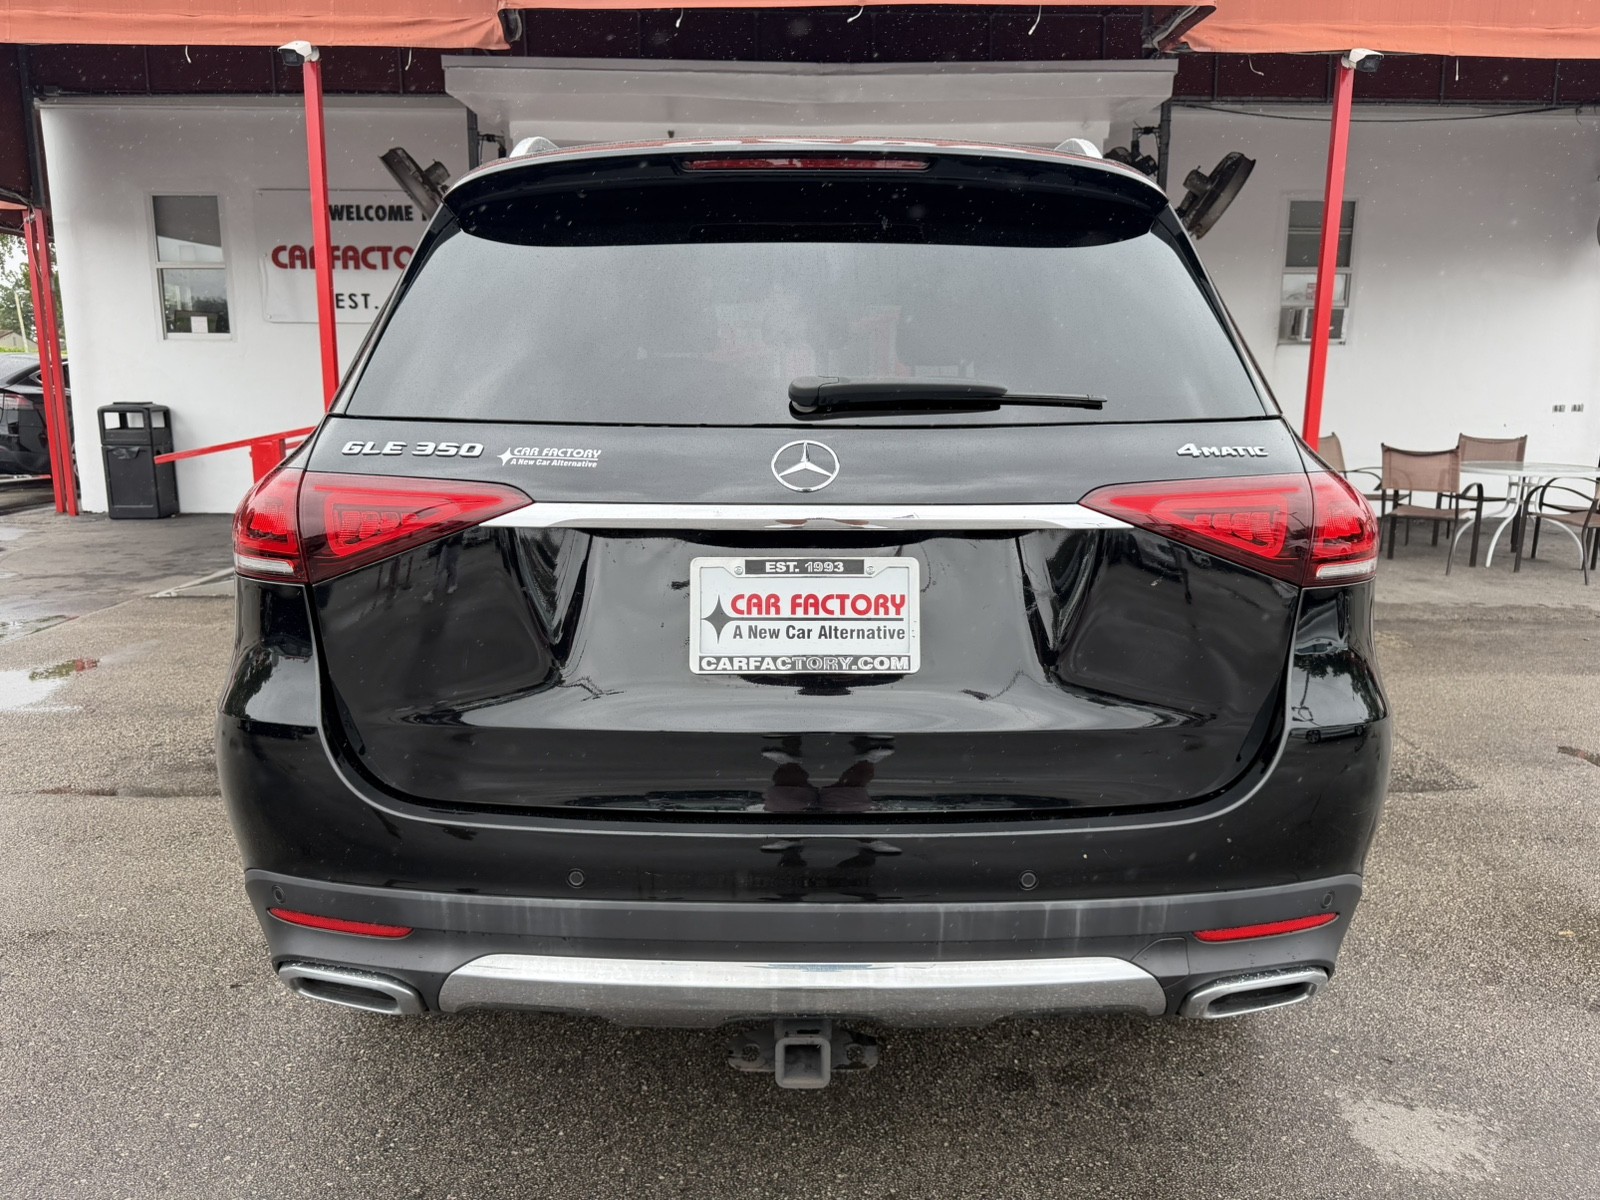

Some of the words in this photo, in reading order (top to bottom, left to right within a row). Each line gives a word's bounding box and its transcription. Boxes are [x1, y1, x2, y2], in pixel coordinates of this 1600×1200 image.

[329, 204, 414, 222] WELCOME
[335, 293, 379, 309] EST.
[341, 440, 406, 455] GLE
[411, 442, 484, 457] 350
[513, 447, 540, 456] CAR
[542, 447, 602, 458] FACTORY
[1176, 443, 1269, 457] 4MATIC
[551, 459, 598, 468] Alternative
[765, 561, 799, 573] EST.
[804, 561, 844, 573] 1993
[730, 593, 781, 616] CAR
[790, 593, 906, 616] FACTORY
[732, 625, 743, 640] A
[748, 625, 781, 640] New
[785, 625, 813, 640] Car
[818, 625, 906, 640] Alternative
[700, 656, 910, 671] CARFACTORY.COM
